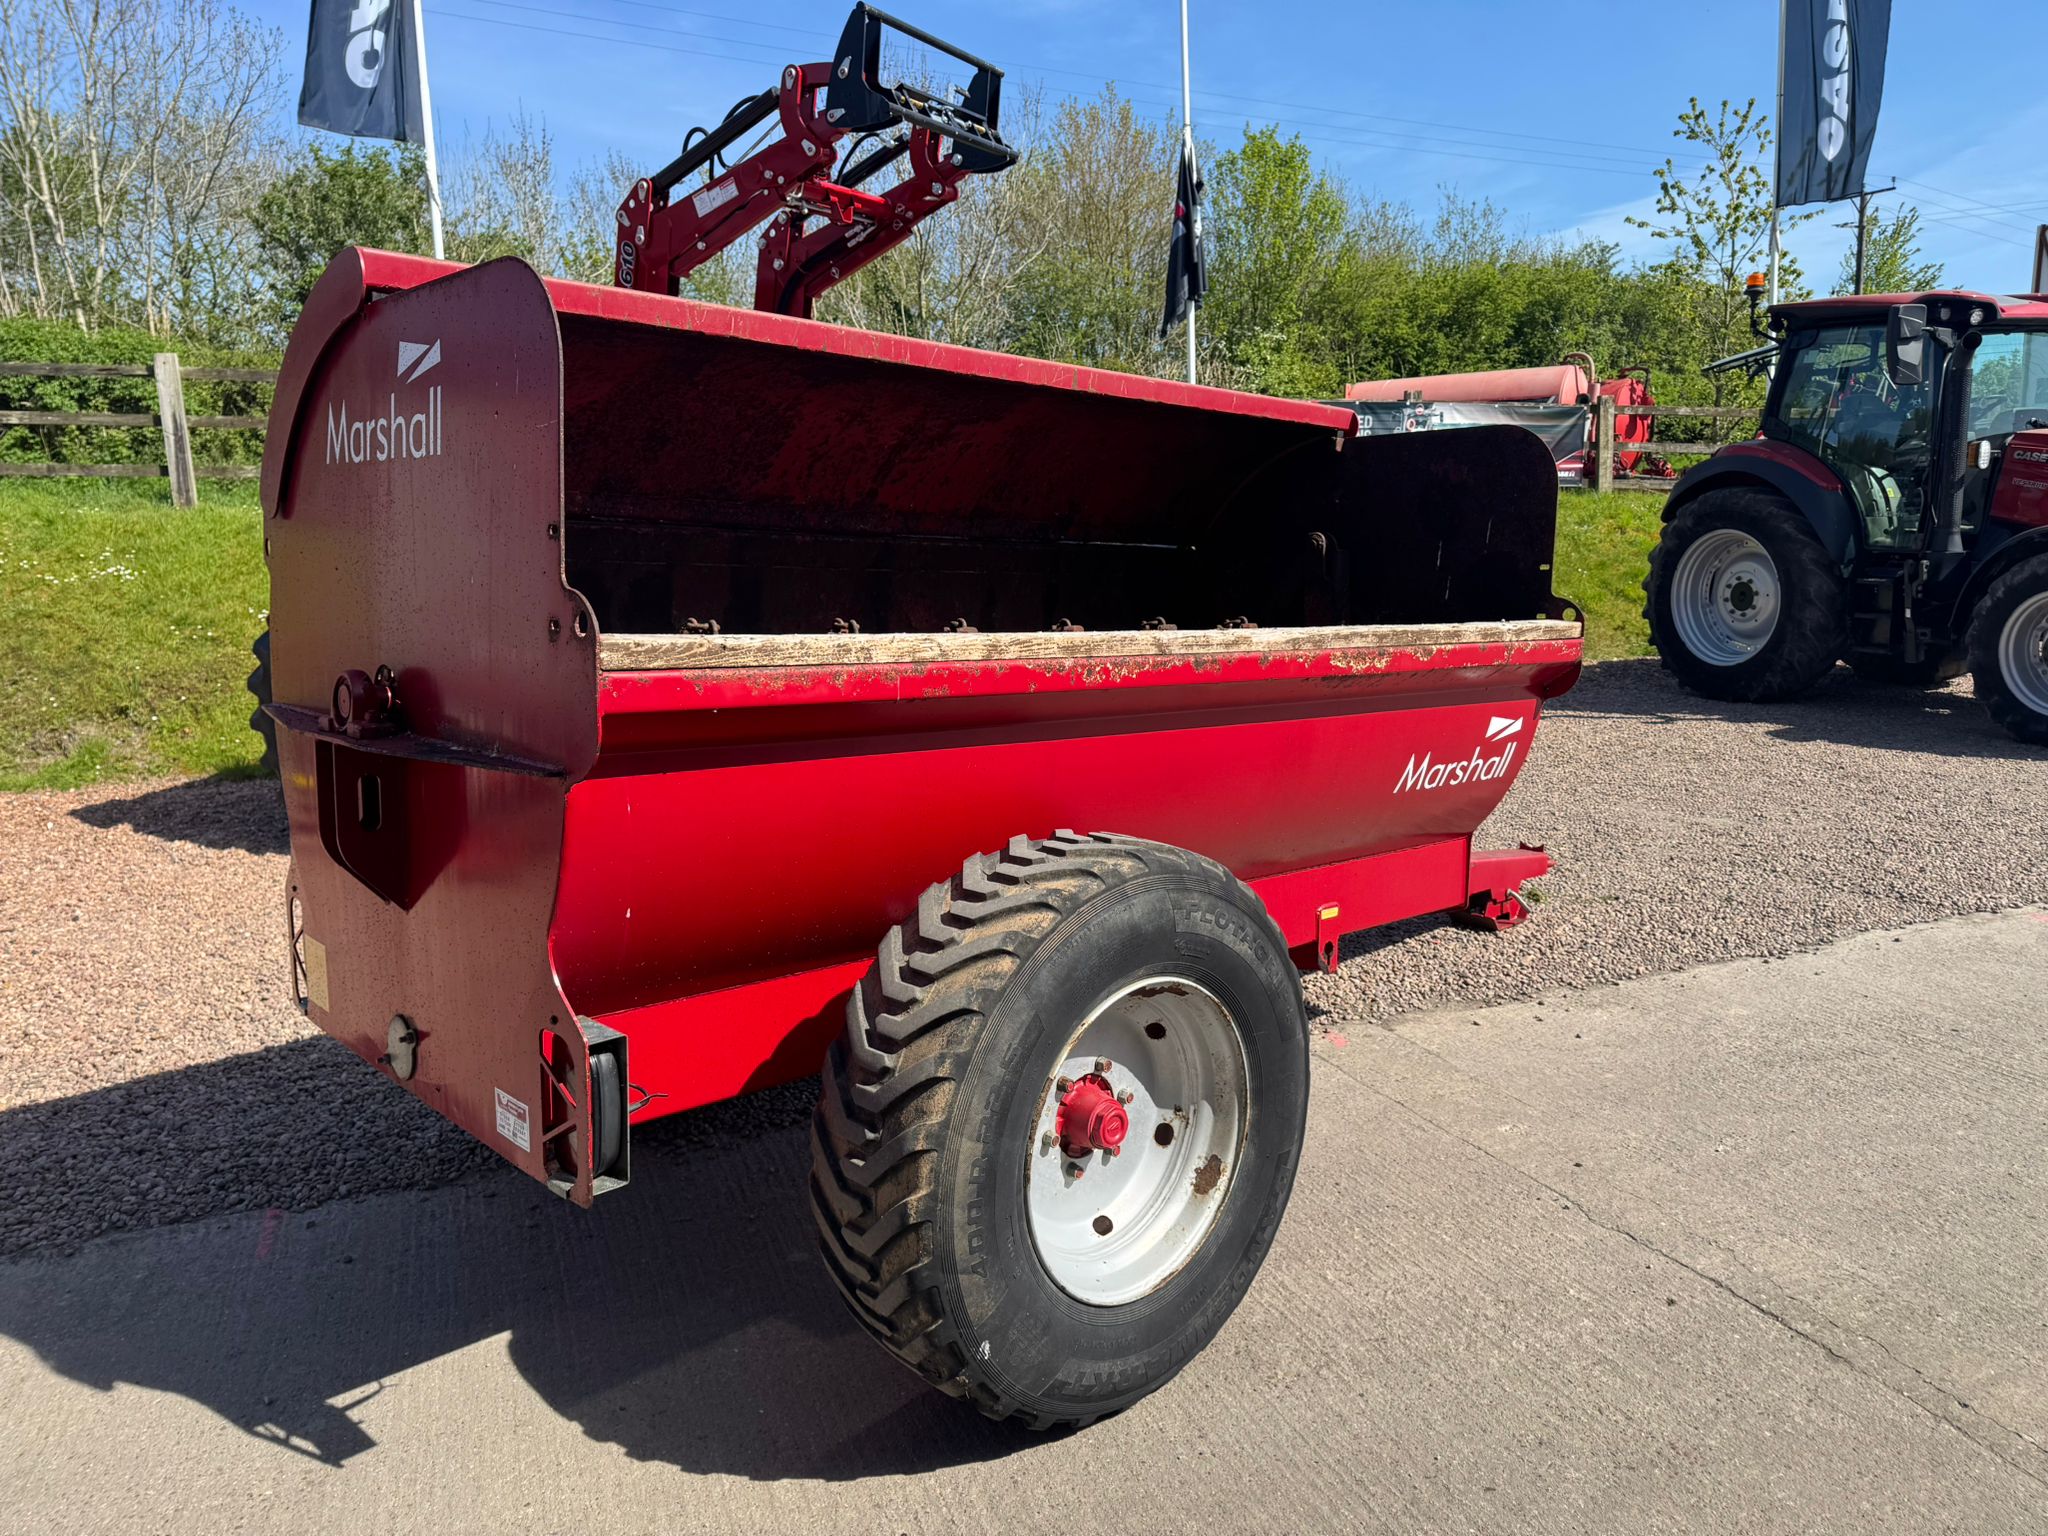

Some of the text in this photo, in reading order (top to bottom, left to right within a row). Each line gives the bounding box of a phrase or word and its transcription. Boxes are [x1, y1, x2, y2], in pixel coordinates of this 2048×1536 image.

[326, 385, 441, 464] Marshall
[2014, 450, 2048, 463] CASE
[1393, 741, 1517, 794] Marshall
